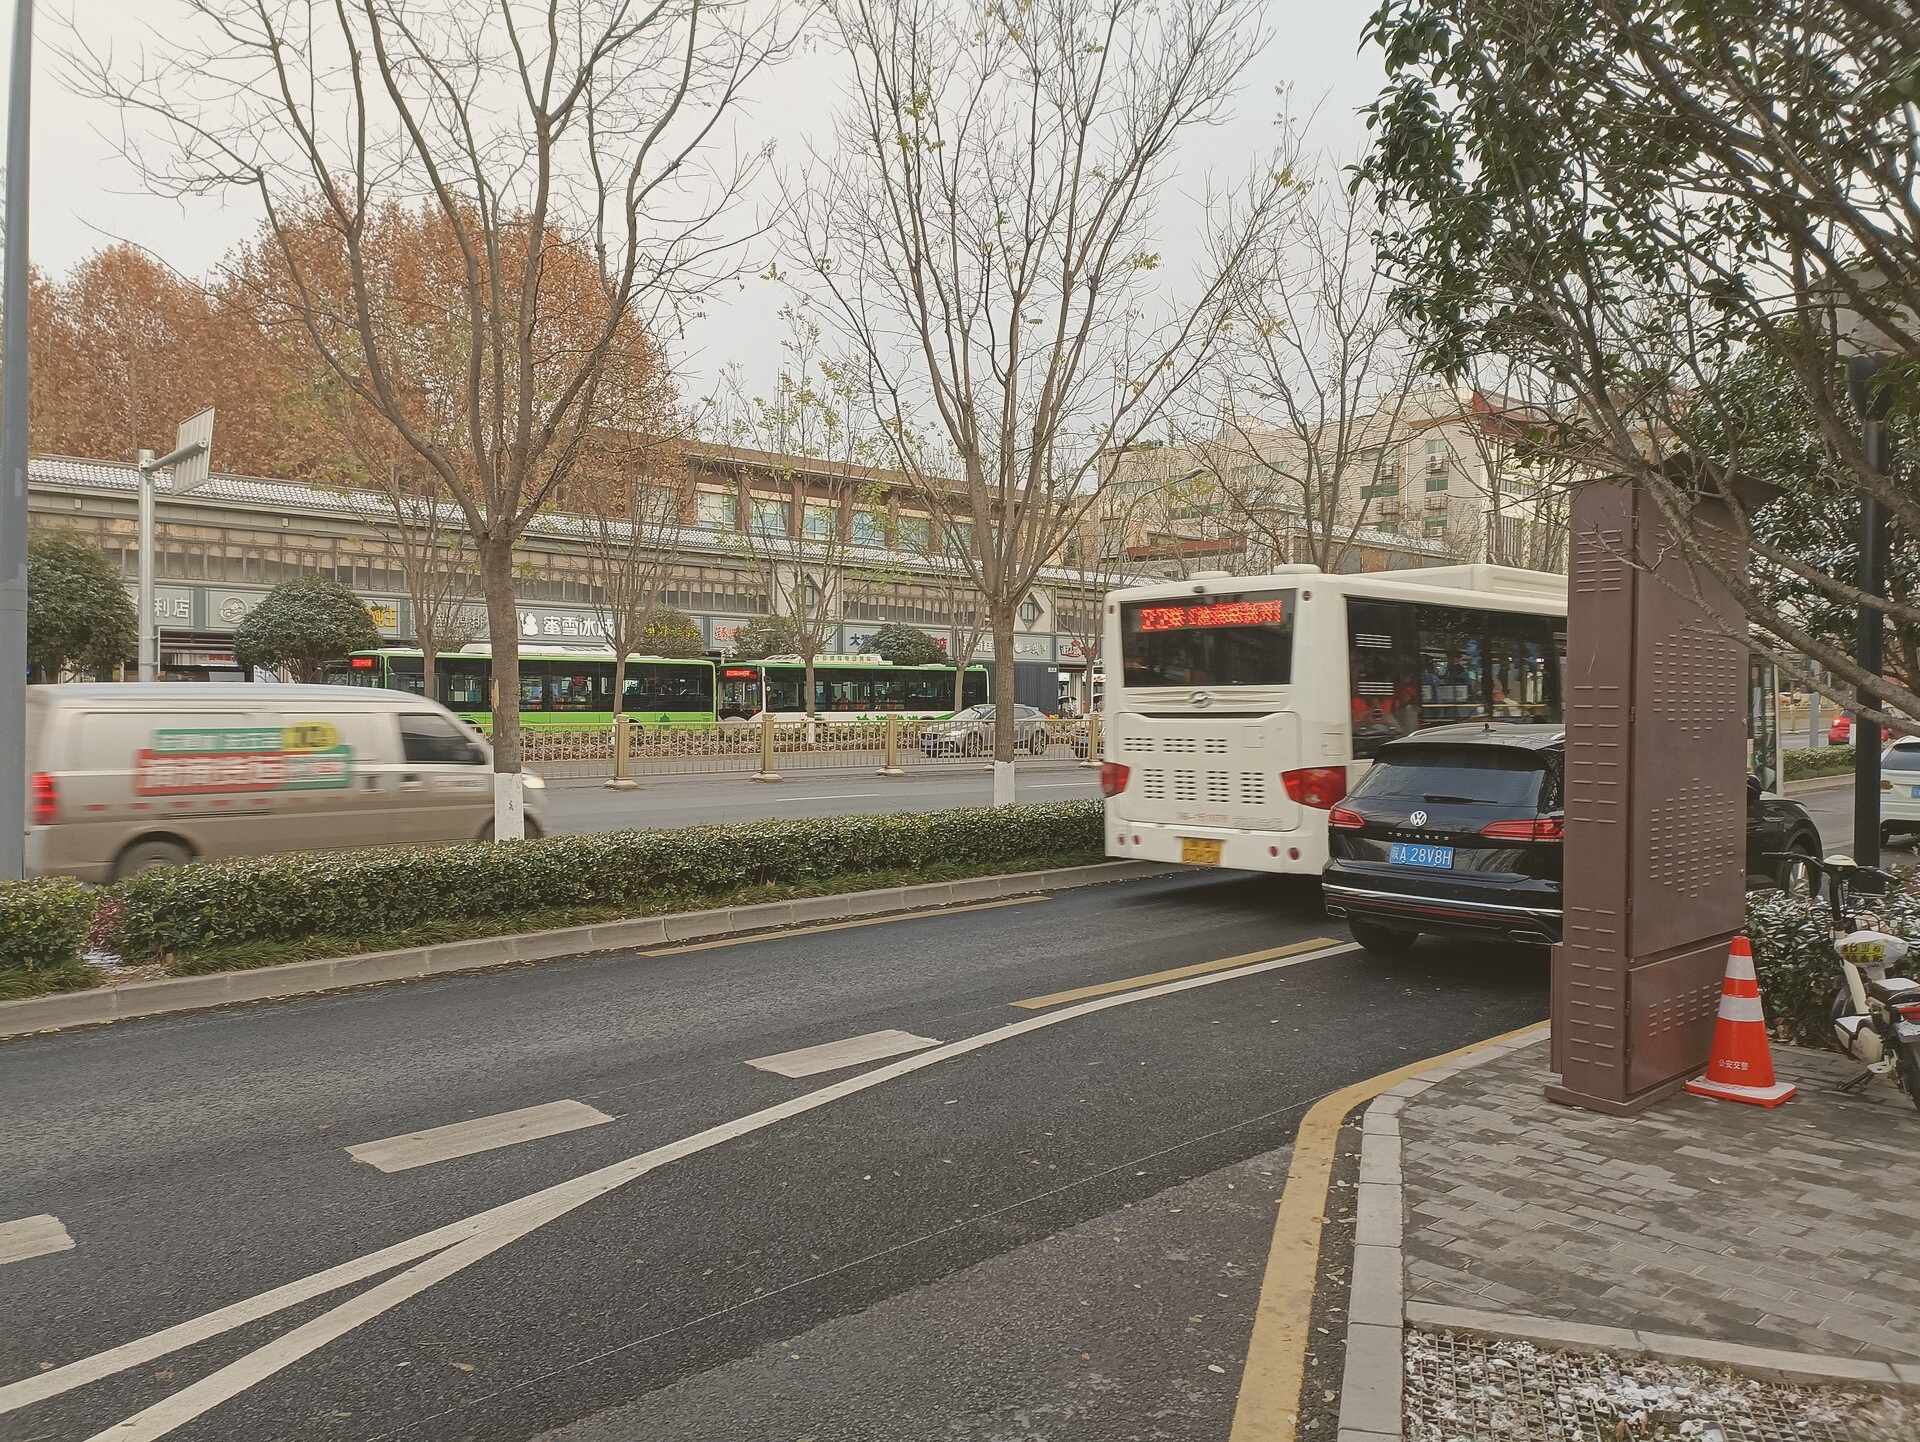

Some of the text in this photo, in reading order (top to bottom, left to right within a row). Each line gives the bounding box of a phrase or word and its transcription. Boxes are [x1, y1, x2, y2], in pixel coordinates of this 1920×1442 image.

[135, 595, 190, 618] 利店
[543, 615, 615, 638] 蜜雪冰城
[1718, 1059, 1749, 1071] 公安交警
